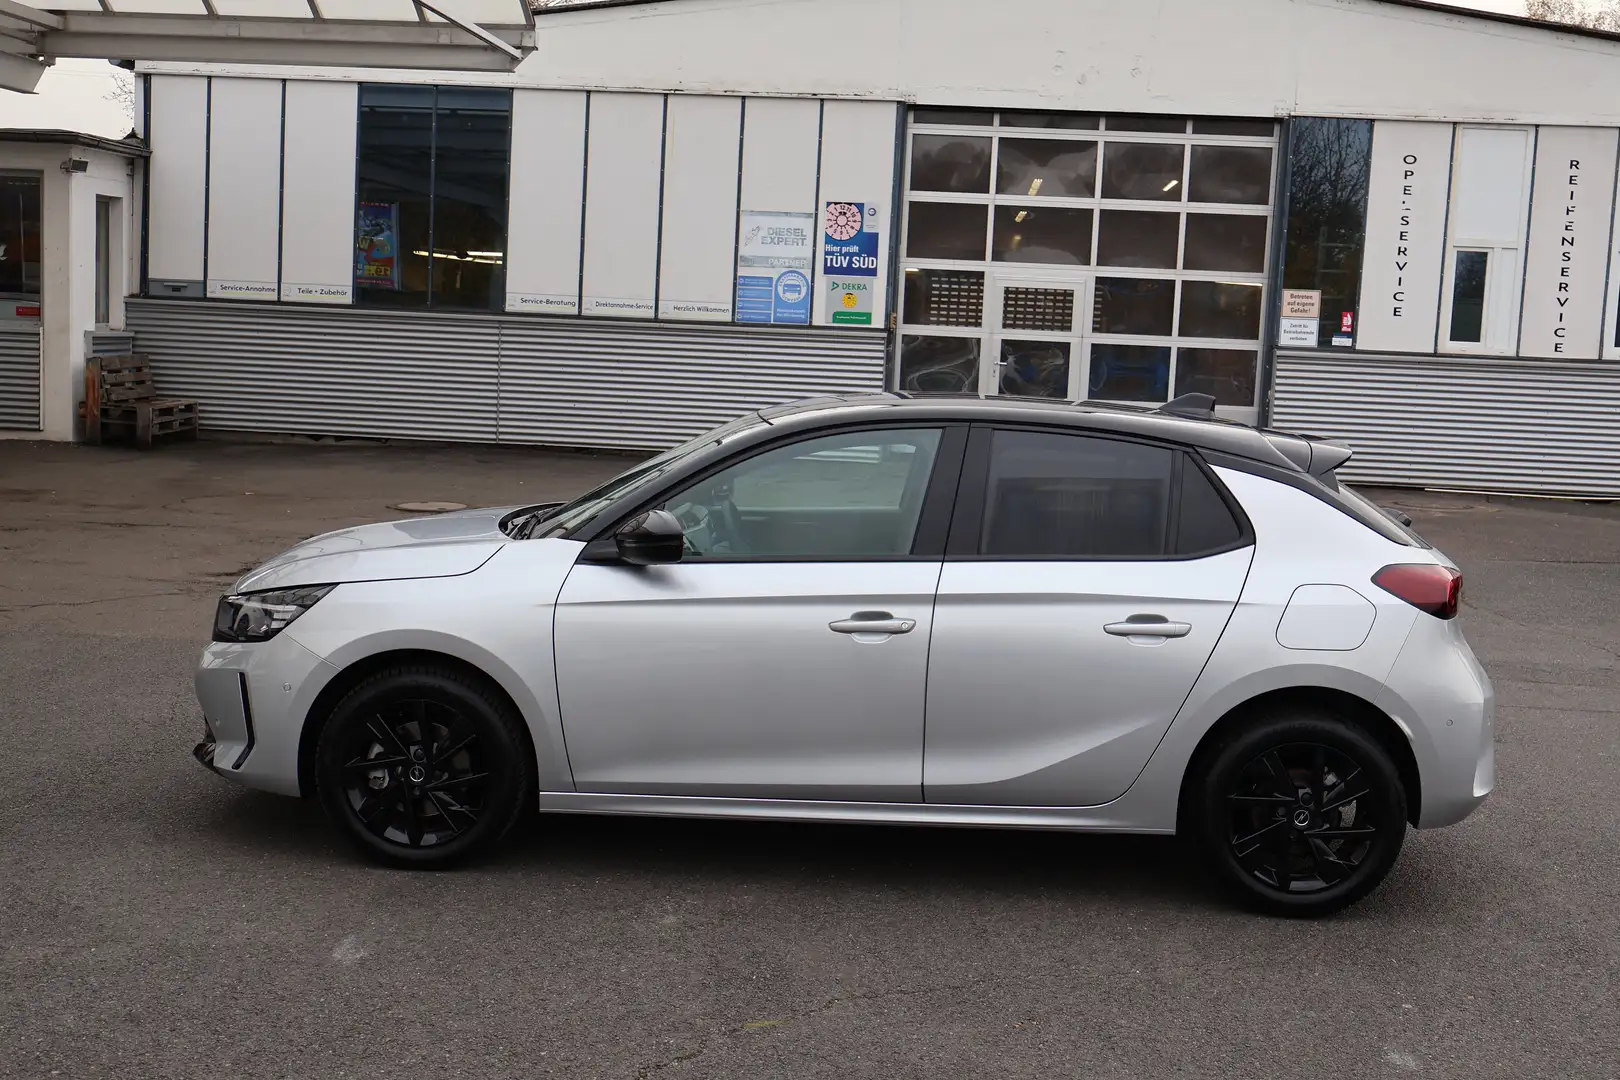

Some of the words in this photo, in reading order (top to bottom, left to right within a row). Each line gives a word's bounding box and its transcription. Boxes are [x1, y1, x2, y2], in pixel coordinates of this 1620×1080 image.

[767, 227, 807, 237] DIESEL
[825, 244, 841, 252] Hier
[841, 245, 859, 254] prüft
[825, 253, 849, 268] TÜV
[851, 254, 877, 269] SÜD
[1554, 160, 1580, 353] REIFENSERVICE
[220, 284, 277, 293] Service-Annahme
[842, 282, 868, 291] DEKRA
[297, 287, 313, 295] Teile
[320, 288, 348, 296] Zubehör
[520, 297, 577, 307] Service-Beratung
[595, 301, 654, 310] Direktannahme-Service
[696, 305, 730, 313] Willkommen
